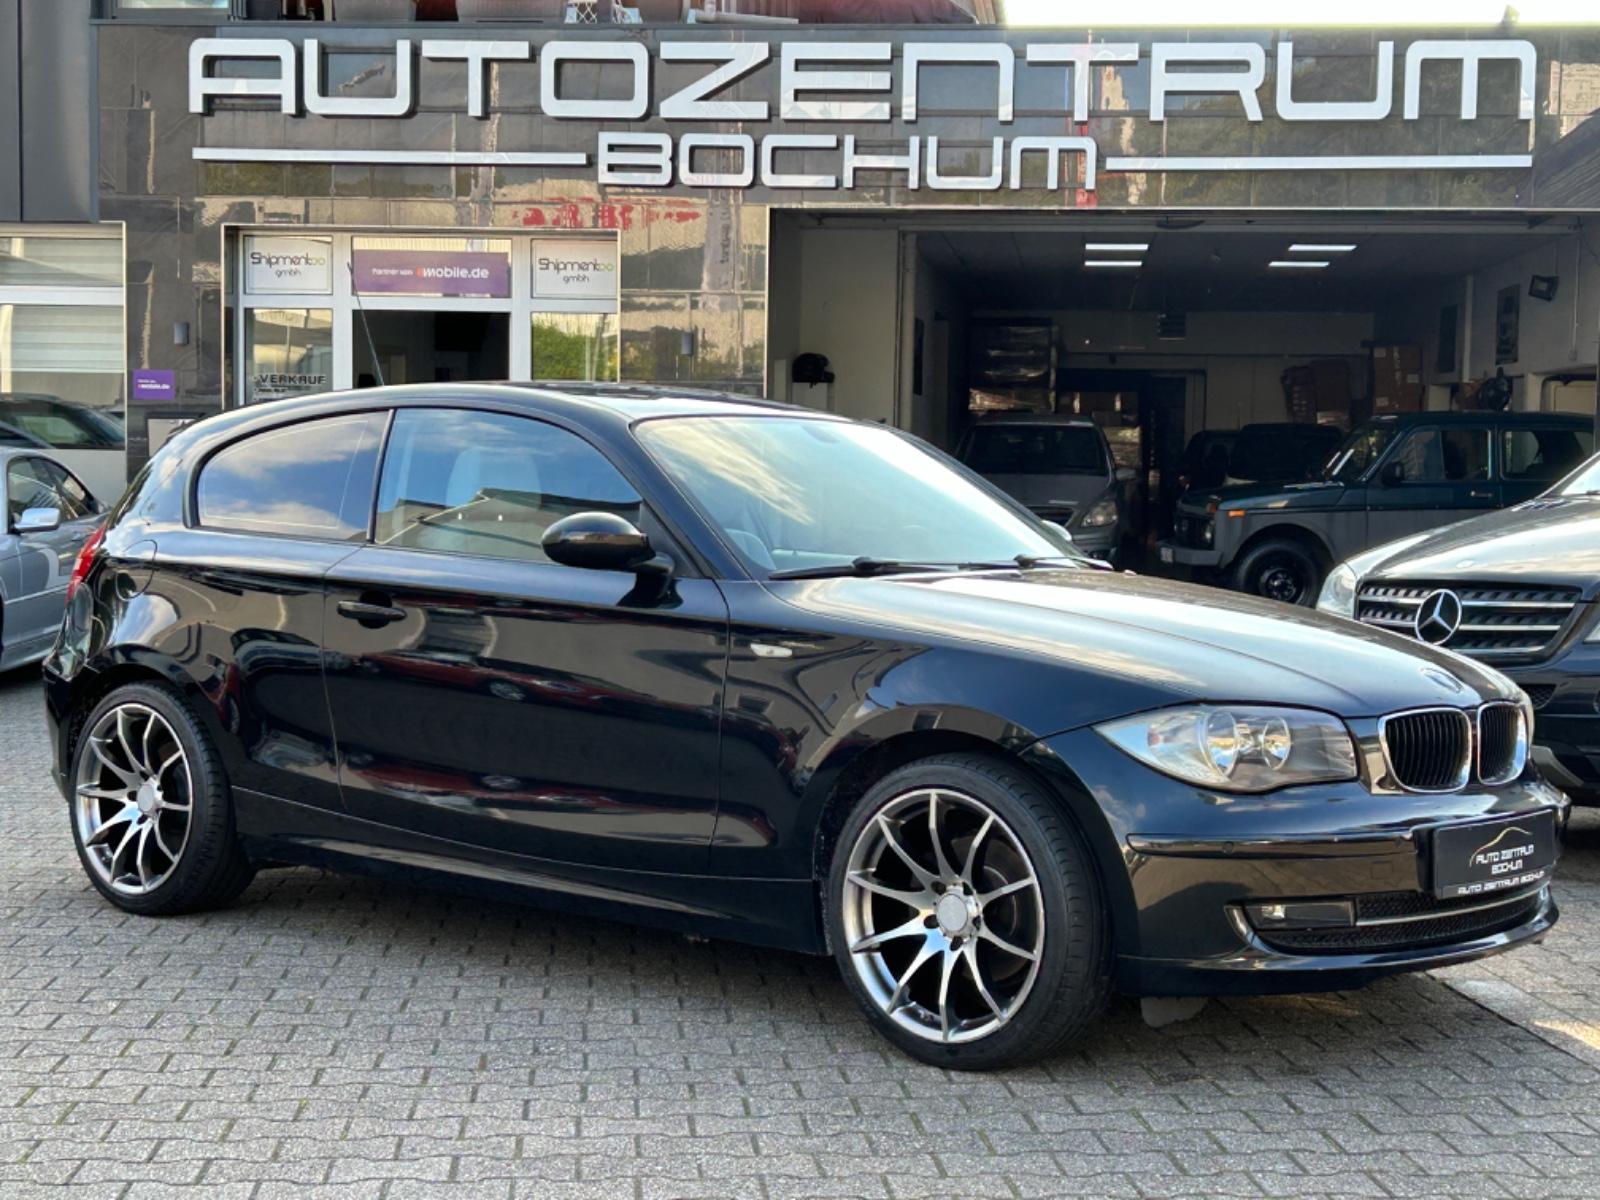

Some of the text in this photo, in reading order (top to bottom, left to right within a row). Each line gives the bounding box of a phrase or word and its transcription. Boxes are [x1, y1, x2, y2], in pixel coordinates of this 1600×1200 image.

[189, 38, 1537, 121] AUTOZENTRUM
[597, 131, 1097, 191] BOCHUM
[423, 266, 489, 279] mobile.de
[260, 374, 327, 385] VERKAUF
